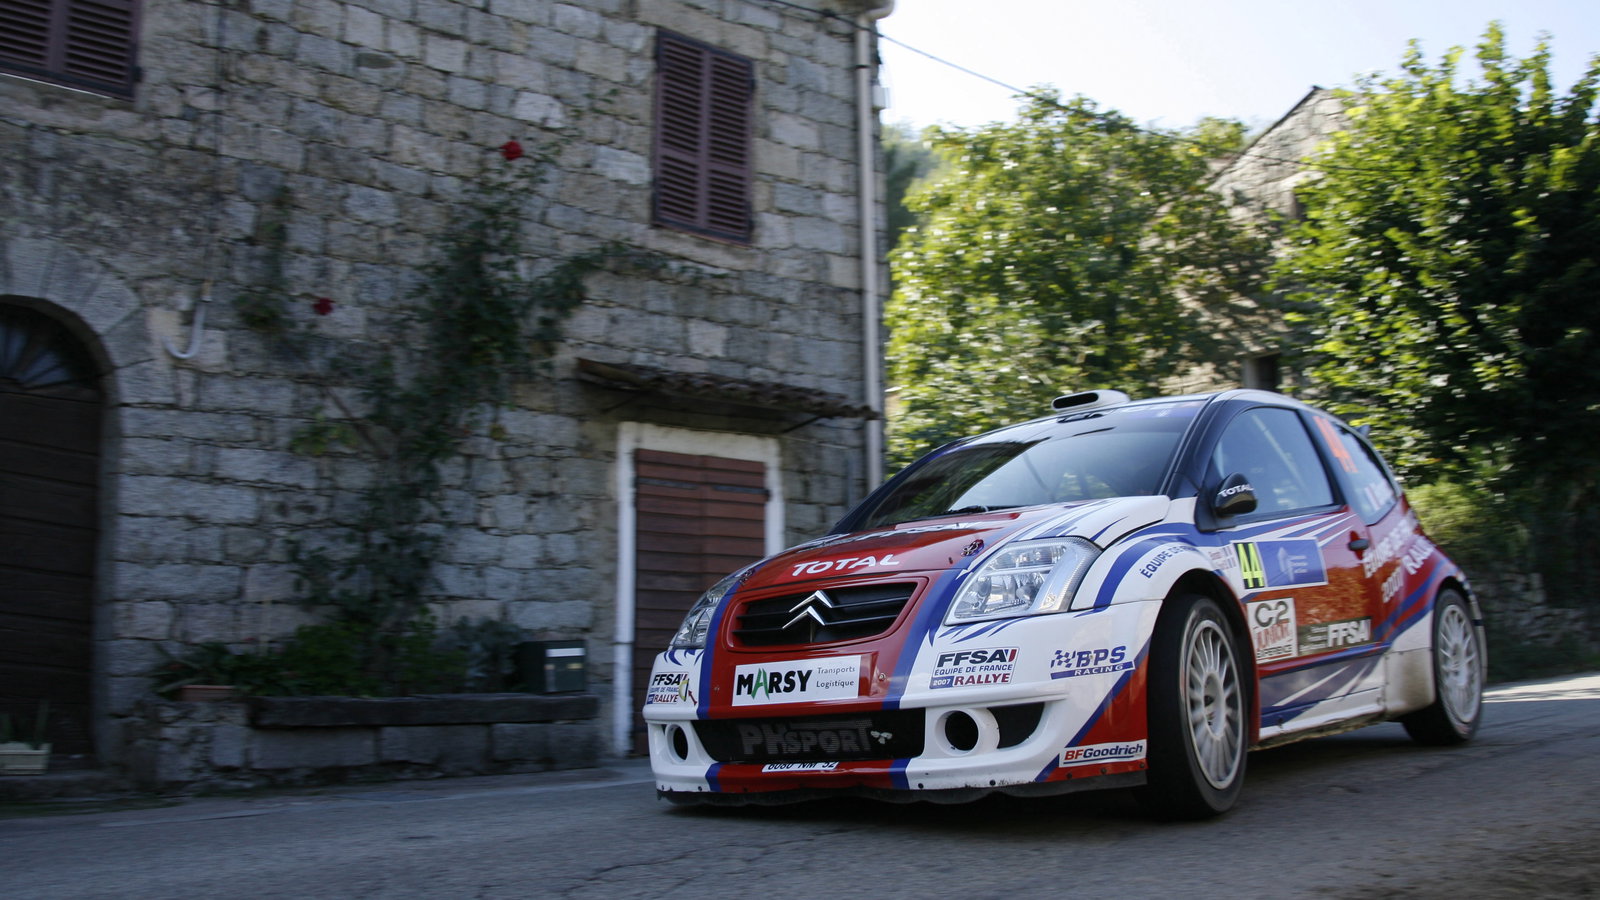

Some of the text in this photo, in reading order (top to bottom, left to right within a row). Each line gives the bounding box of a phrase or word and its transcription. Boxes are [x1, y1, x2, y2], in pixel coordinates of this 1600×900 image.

[1217, 484, 1254, 498] TOTAL
[791, 554, 900, 576] TOTAL
[1140, 551, 1173, 579] ÉQUIPE
[1236, 542, 1265, 588] 44
[1255, 601, 1290, 628] C2
[1328, 619, 1369, 648] FFSA
[937, 649, 1007, 667] FFSA
[1076, 645, 1126, 668] BPS
[817, 666, 856, 676] Transports
[979, 664, 1013, 672] FRANCE
[1074, 665, 1124, 676] RACING
[652, 673, 681, 686] FFSA
[736, 667, 813, 700] MARSY
[816, 680, 855, 690] Logistique
[933, 673, 1011, 686] 2007 RALLYE
[653, 694, 679, 703] RALLYE
[1064, 744, 1143, 761] BFGoodrich
